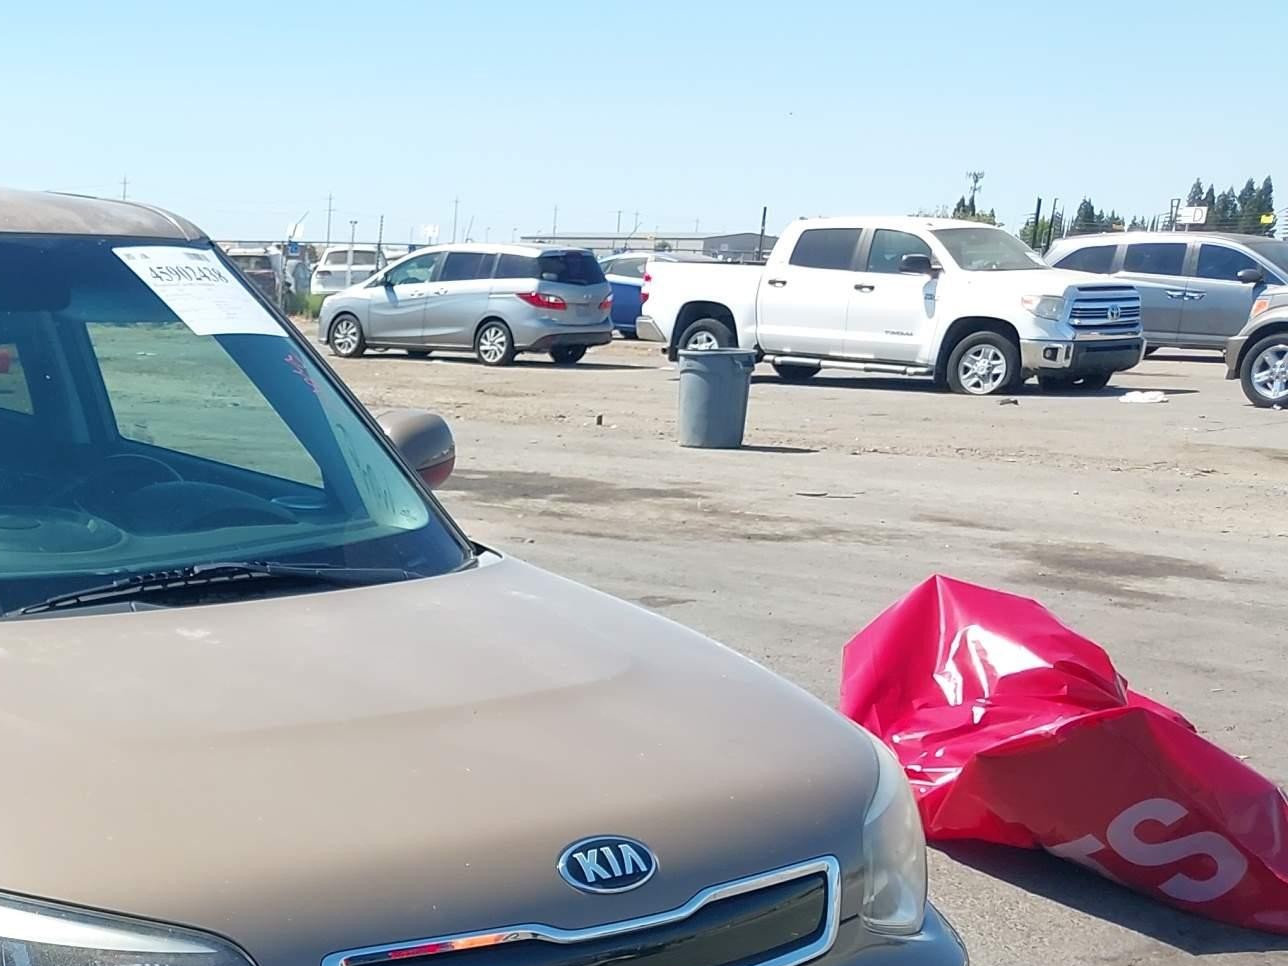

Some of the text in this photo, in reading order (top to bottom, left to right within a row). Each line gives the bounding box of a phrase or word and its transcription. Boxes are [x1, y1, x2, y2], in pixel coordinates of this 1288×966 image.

[1192, 207, 1204, 222] D
[148, 266, 229, 283] 45902438
[572, 843, 648, 883] KIA
